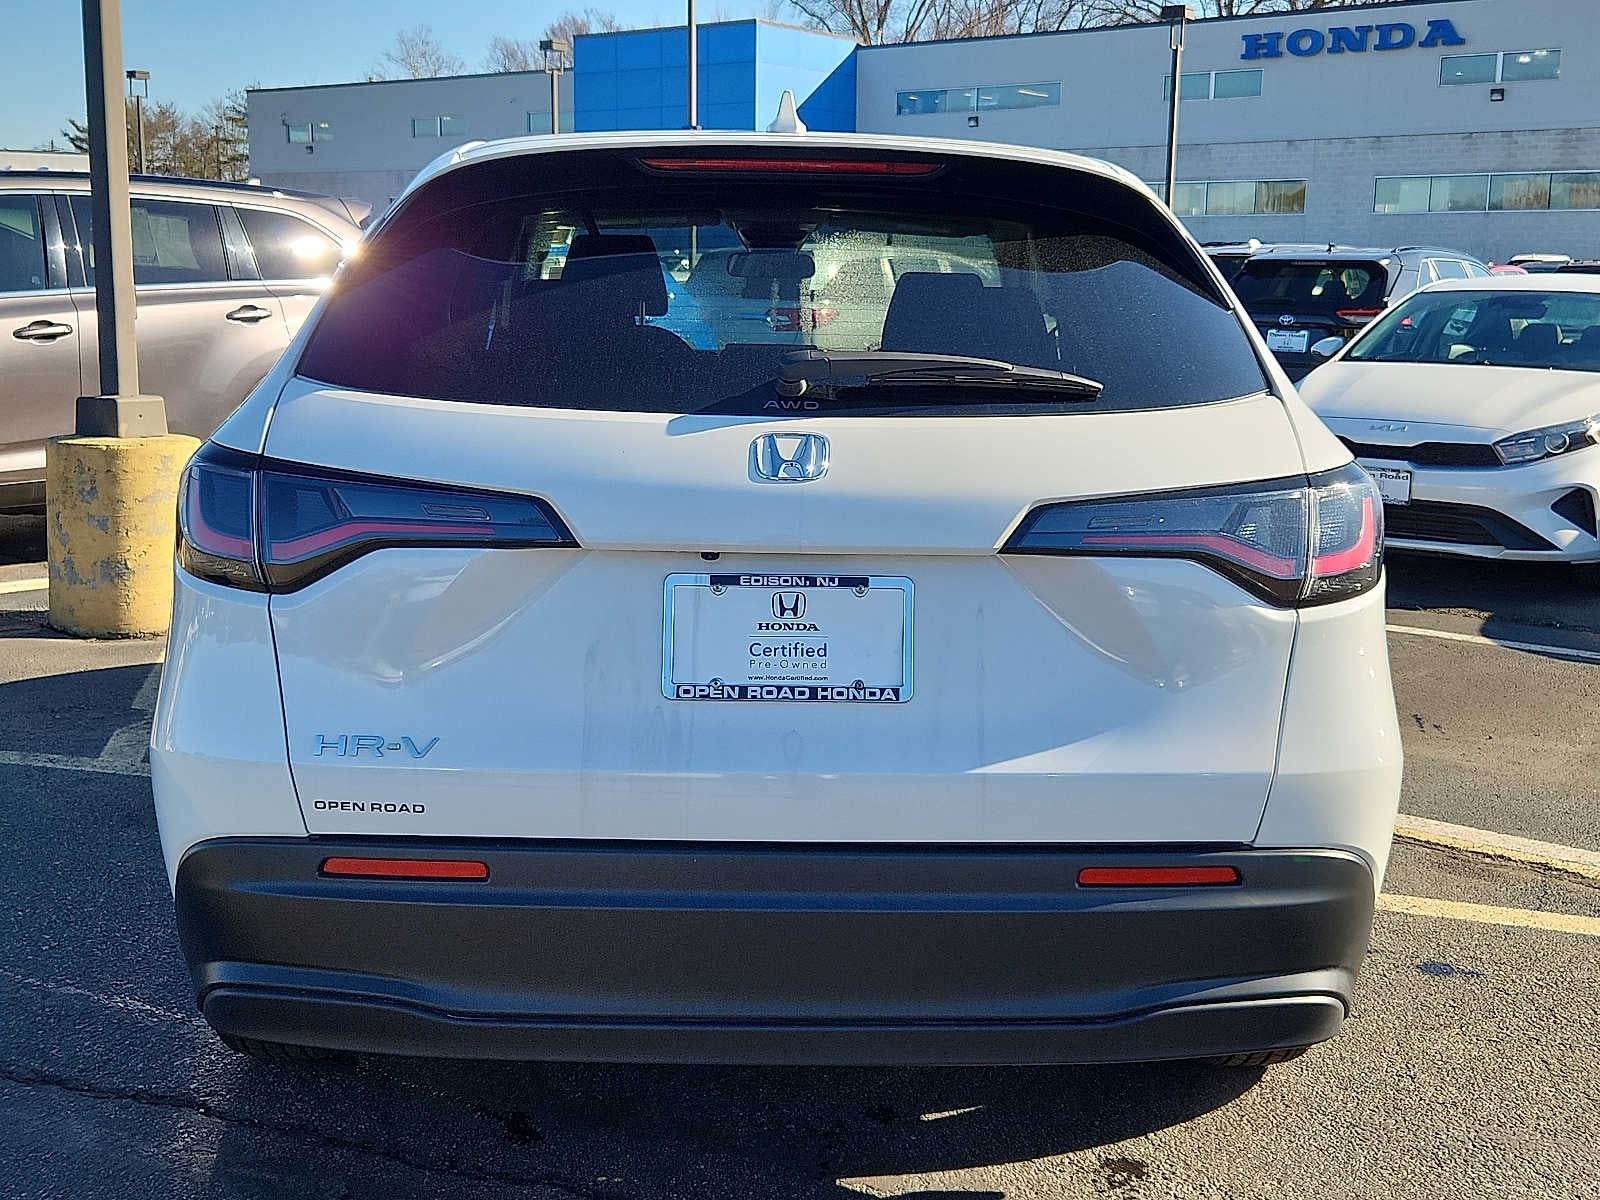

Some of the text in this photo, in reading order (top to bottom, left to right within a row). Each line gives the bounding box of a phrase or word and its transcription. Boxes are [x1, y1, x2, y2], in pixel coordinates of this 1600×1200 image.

[1240, 19, 1466, 60] HONDA
[763, 400, 819, 410] AWD
[1379, 472, 1409, 481] Road
[739, 575, 839, 587] EDISON, NJ
[756, 622, 820, 632] HONDA
[749, 641, 828, 658] Certified
[749, 659, 828, 669] Pre-Owned
[747, 674, 829, 682] www.HondaCertified.com
[678, 685, 897, 700] OPEN ROAD HONDA
[313, 734, 440, 758] HR-V
[314, 800, 425, 814] OPEN ROAD
